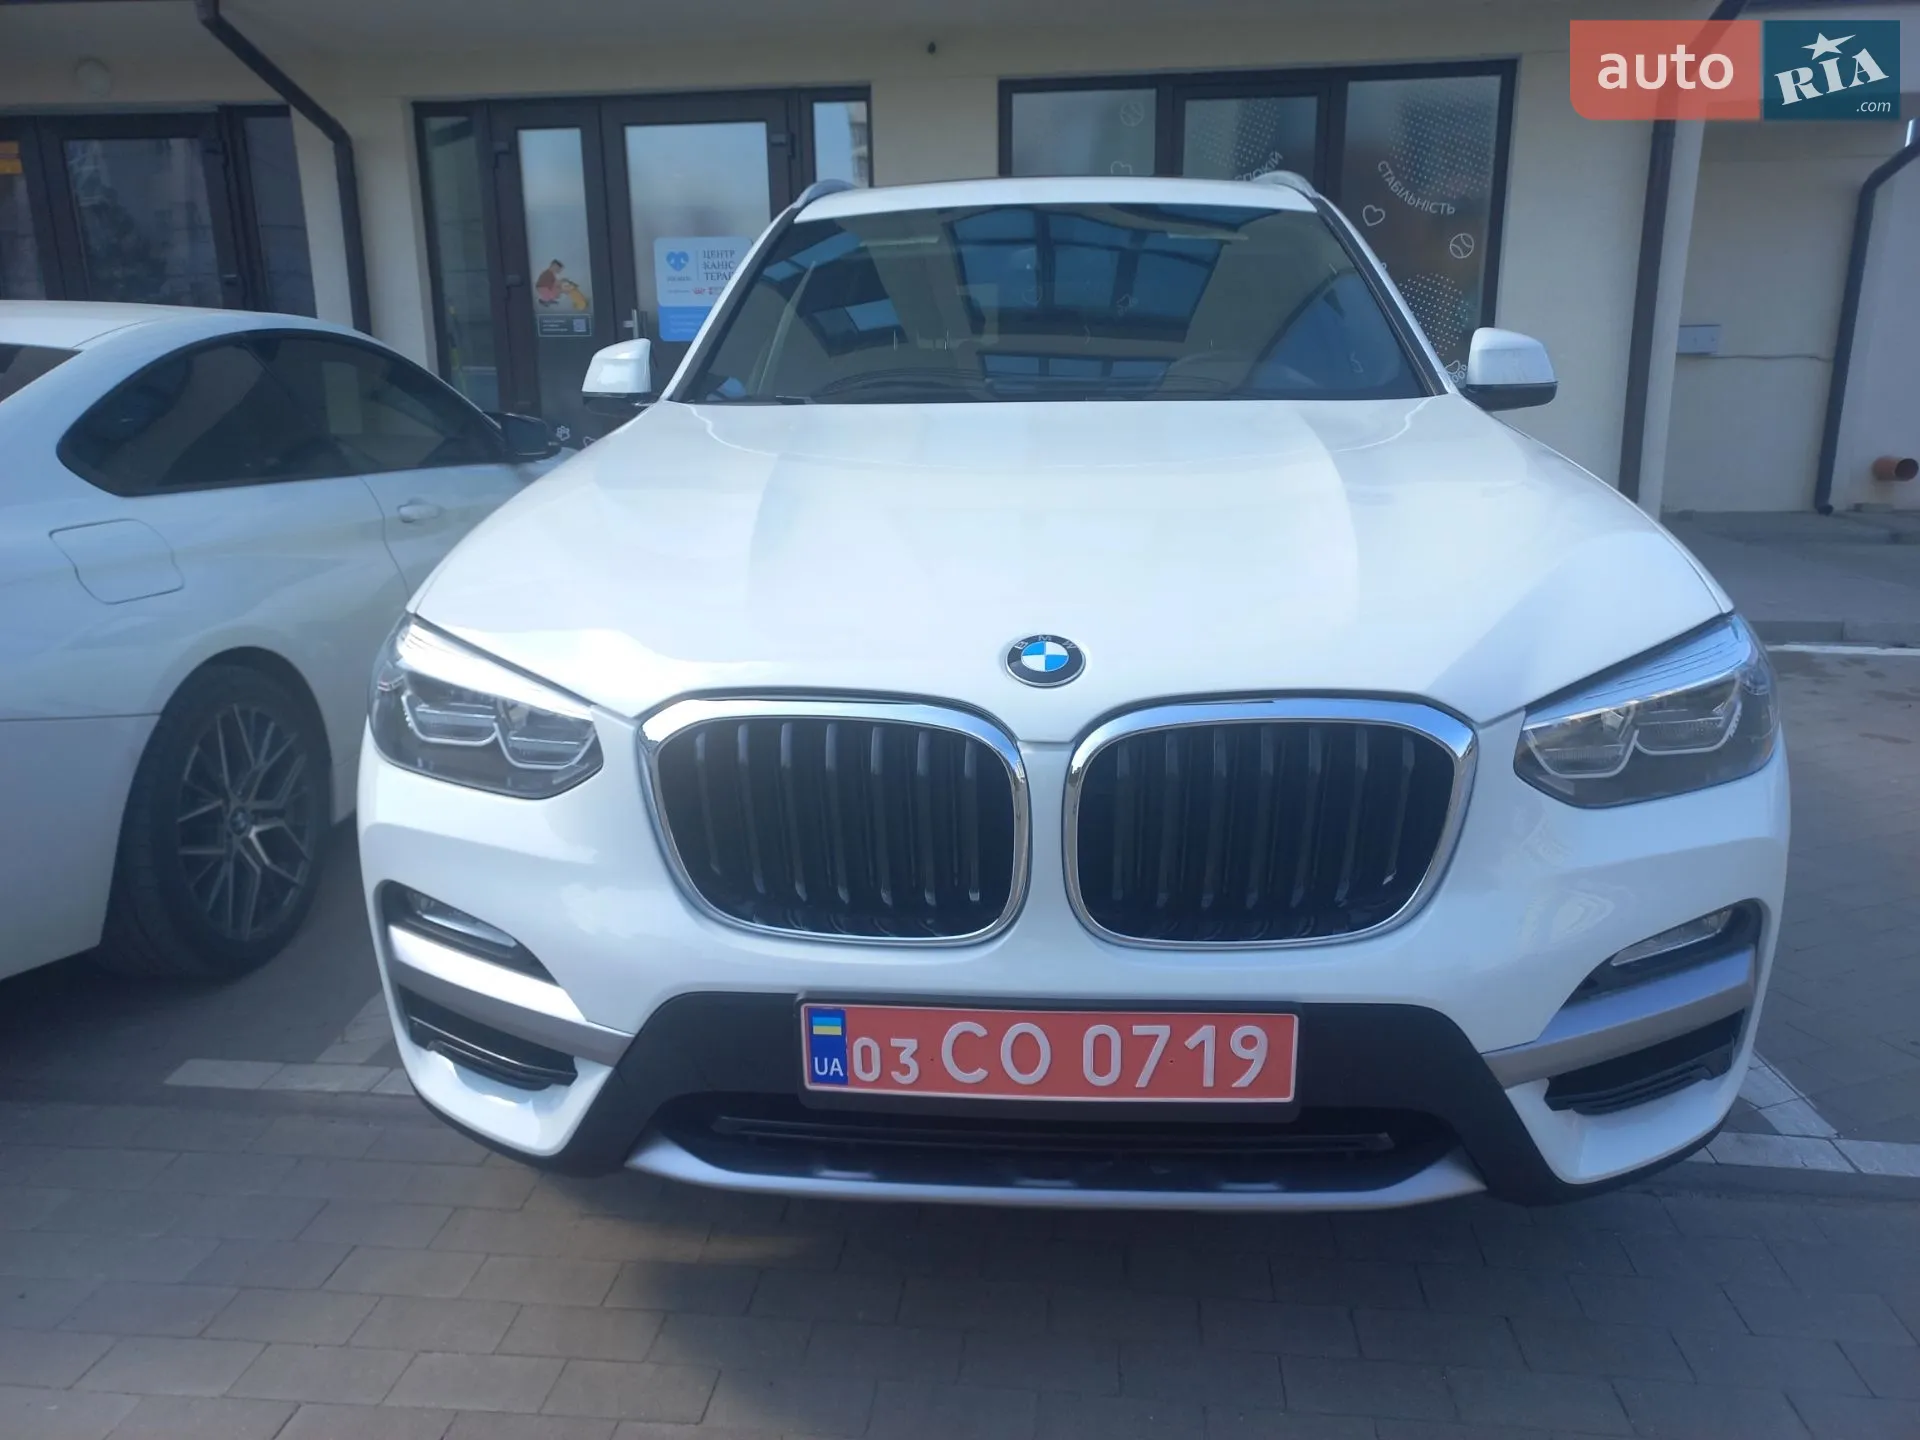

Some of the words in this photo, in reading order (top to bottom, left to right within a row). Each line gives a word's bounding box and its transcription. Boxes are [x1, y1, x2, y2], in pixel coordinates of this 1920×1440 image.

[1378, 160, 1456, 215] СТАБІЛЬНІСТЬ
[703, 249, 735, 259] ЦЕНТР
[1014, 634, 1077, 649] BMW
[852, 1037, 920, 1085] 03
[941, 1021, 1052, 1086] CO
[1082, 1024, 1269, 1088] 0719
[814, 1057, 844, 1077] UA
